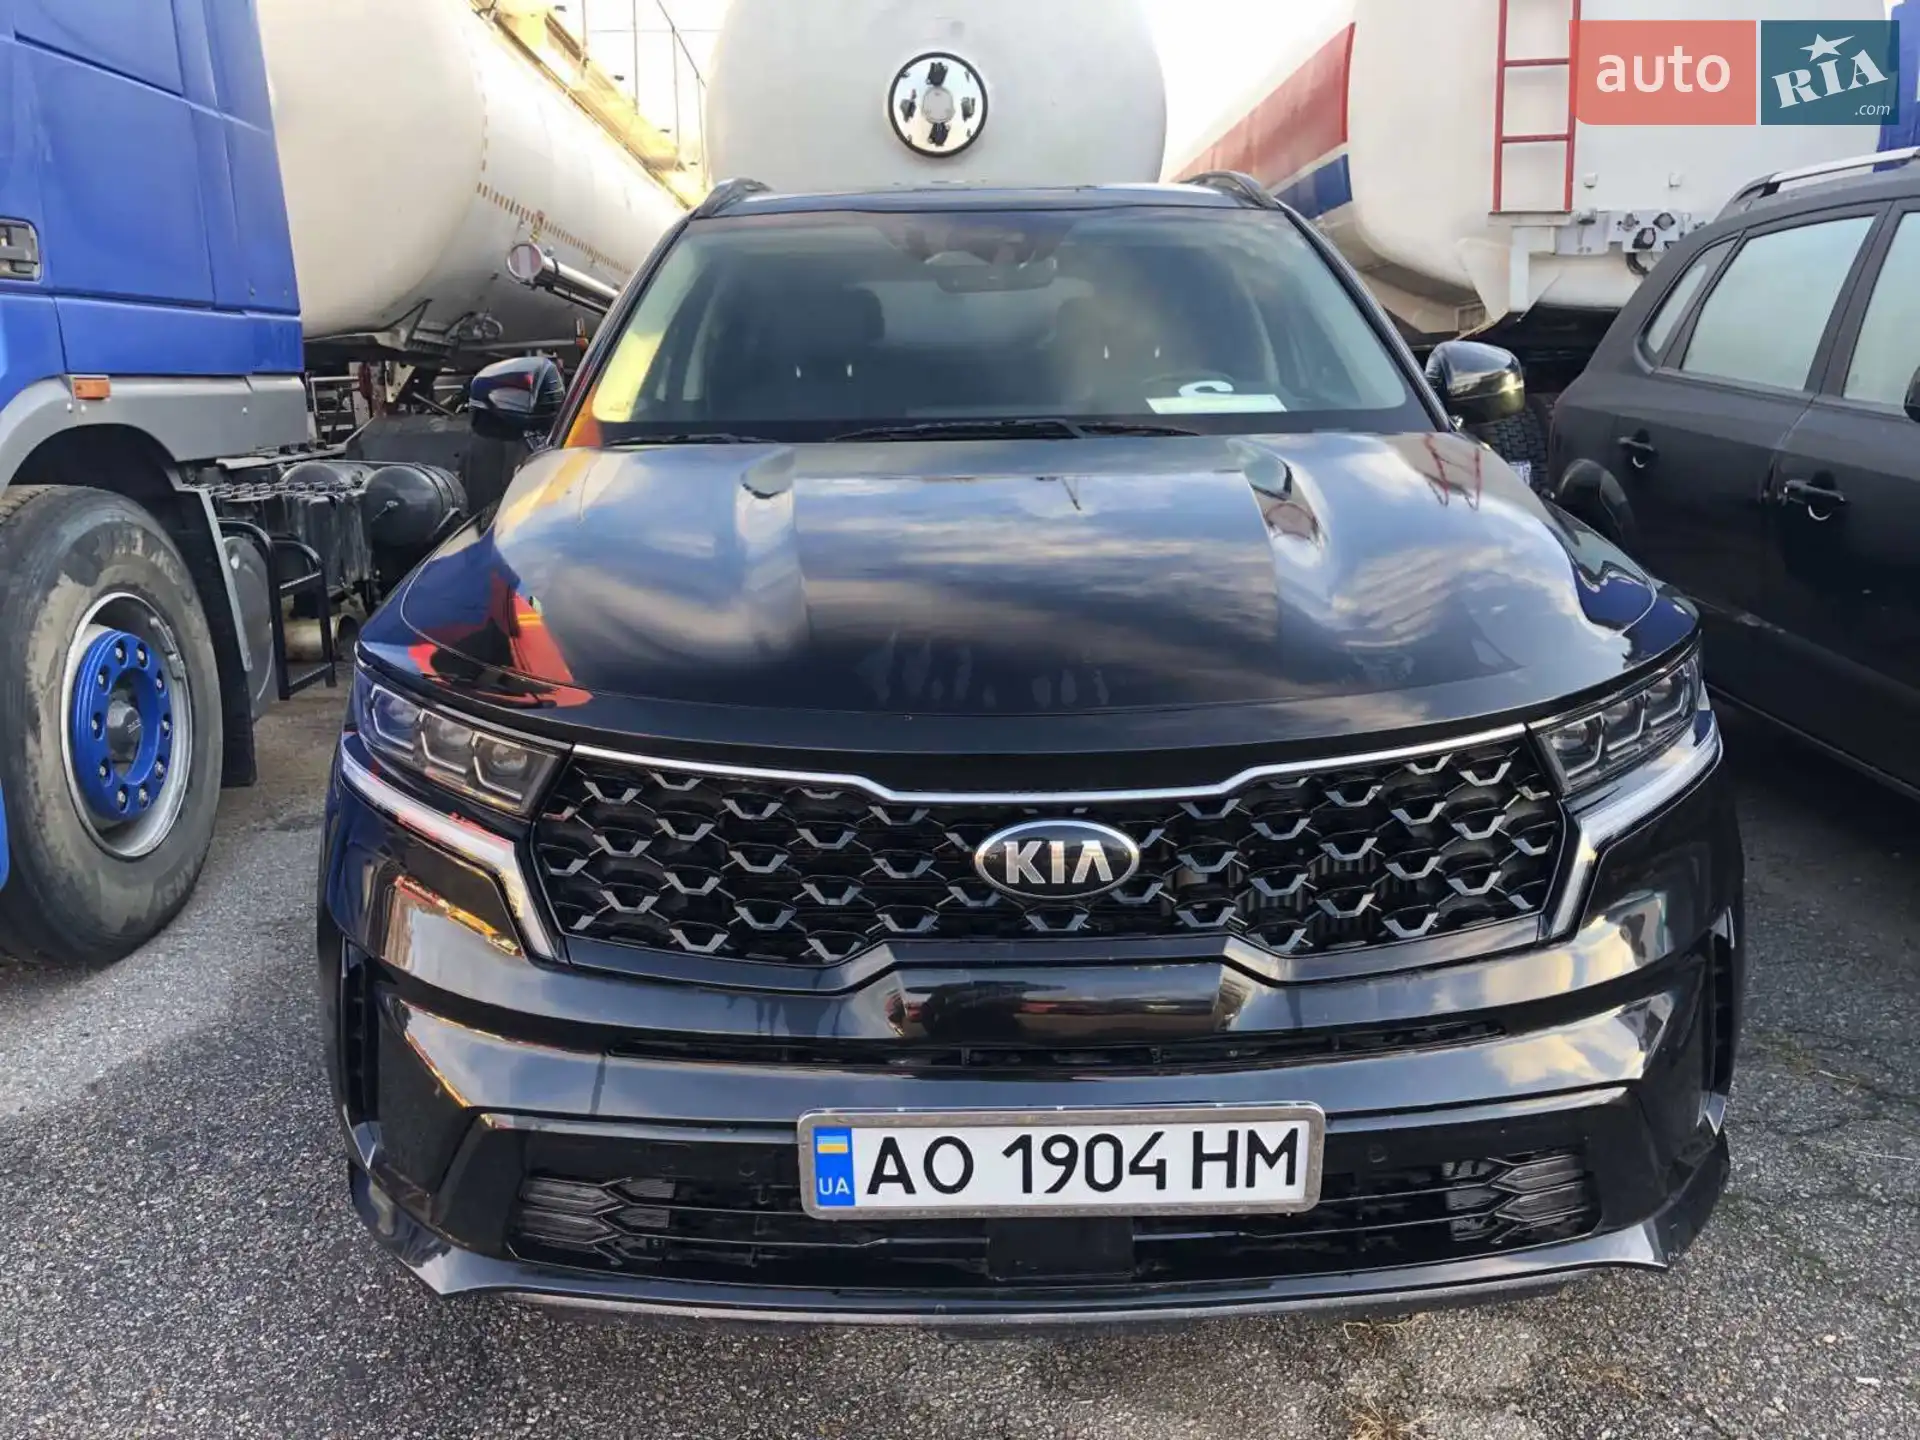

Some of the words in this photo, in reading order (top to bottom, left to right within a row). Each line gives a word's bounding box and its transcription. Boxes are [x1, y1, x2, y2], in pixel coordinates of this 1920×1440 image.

[1004, 840, 1114, 884] KIA
[866, 1136, 974, 1196] AO
[1002, 1131, 1167, 1194] 1904
[1192, 1128, 1299, 1190] HM
[818, 1177, 851, 1196] UA
